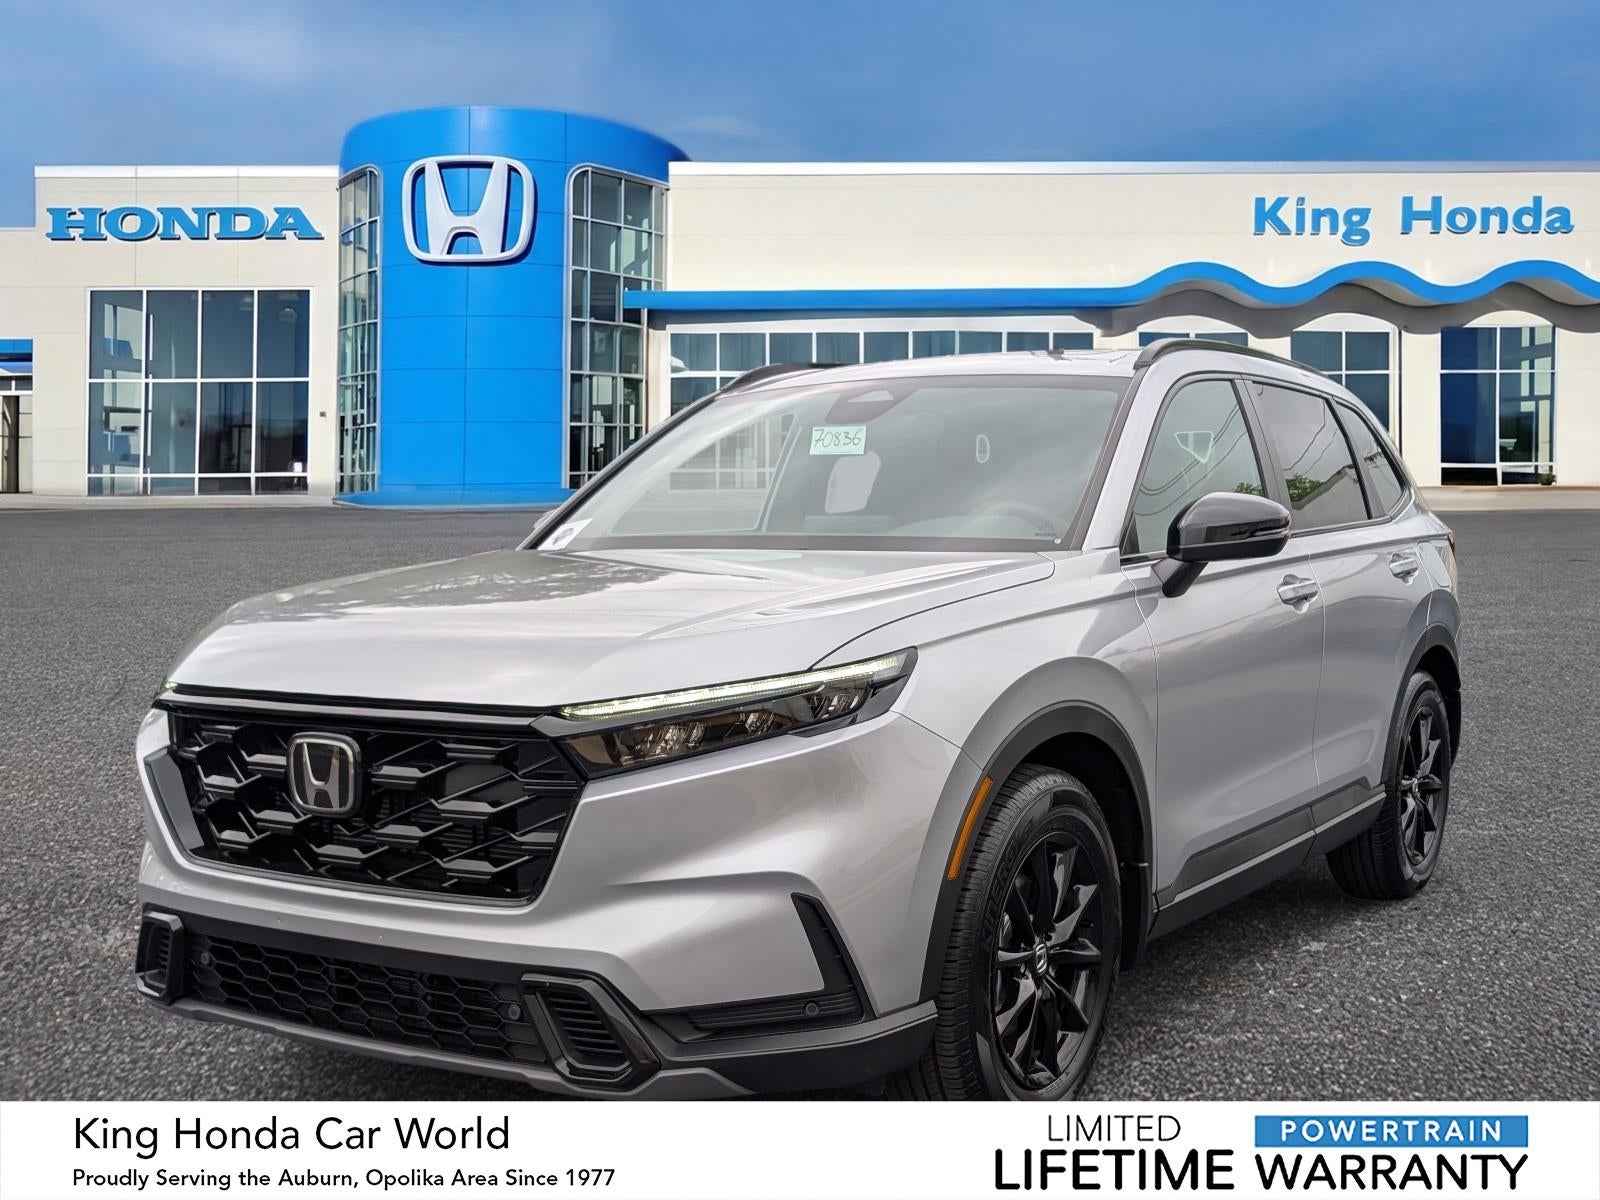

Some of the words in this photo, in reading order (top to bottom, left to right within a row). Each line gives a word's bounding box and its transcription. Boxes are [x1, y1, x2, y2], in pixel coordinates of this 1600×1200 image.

[45, 206, 325, 242] HONDA
[1253, 196, 1372, 247] King
[1400, 195, 1575, 235] Honda
[813, 428, 864, 448] 70836
